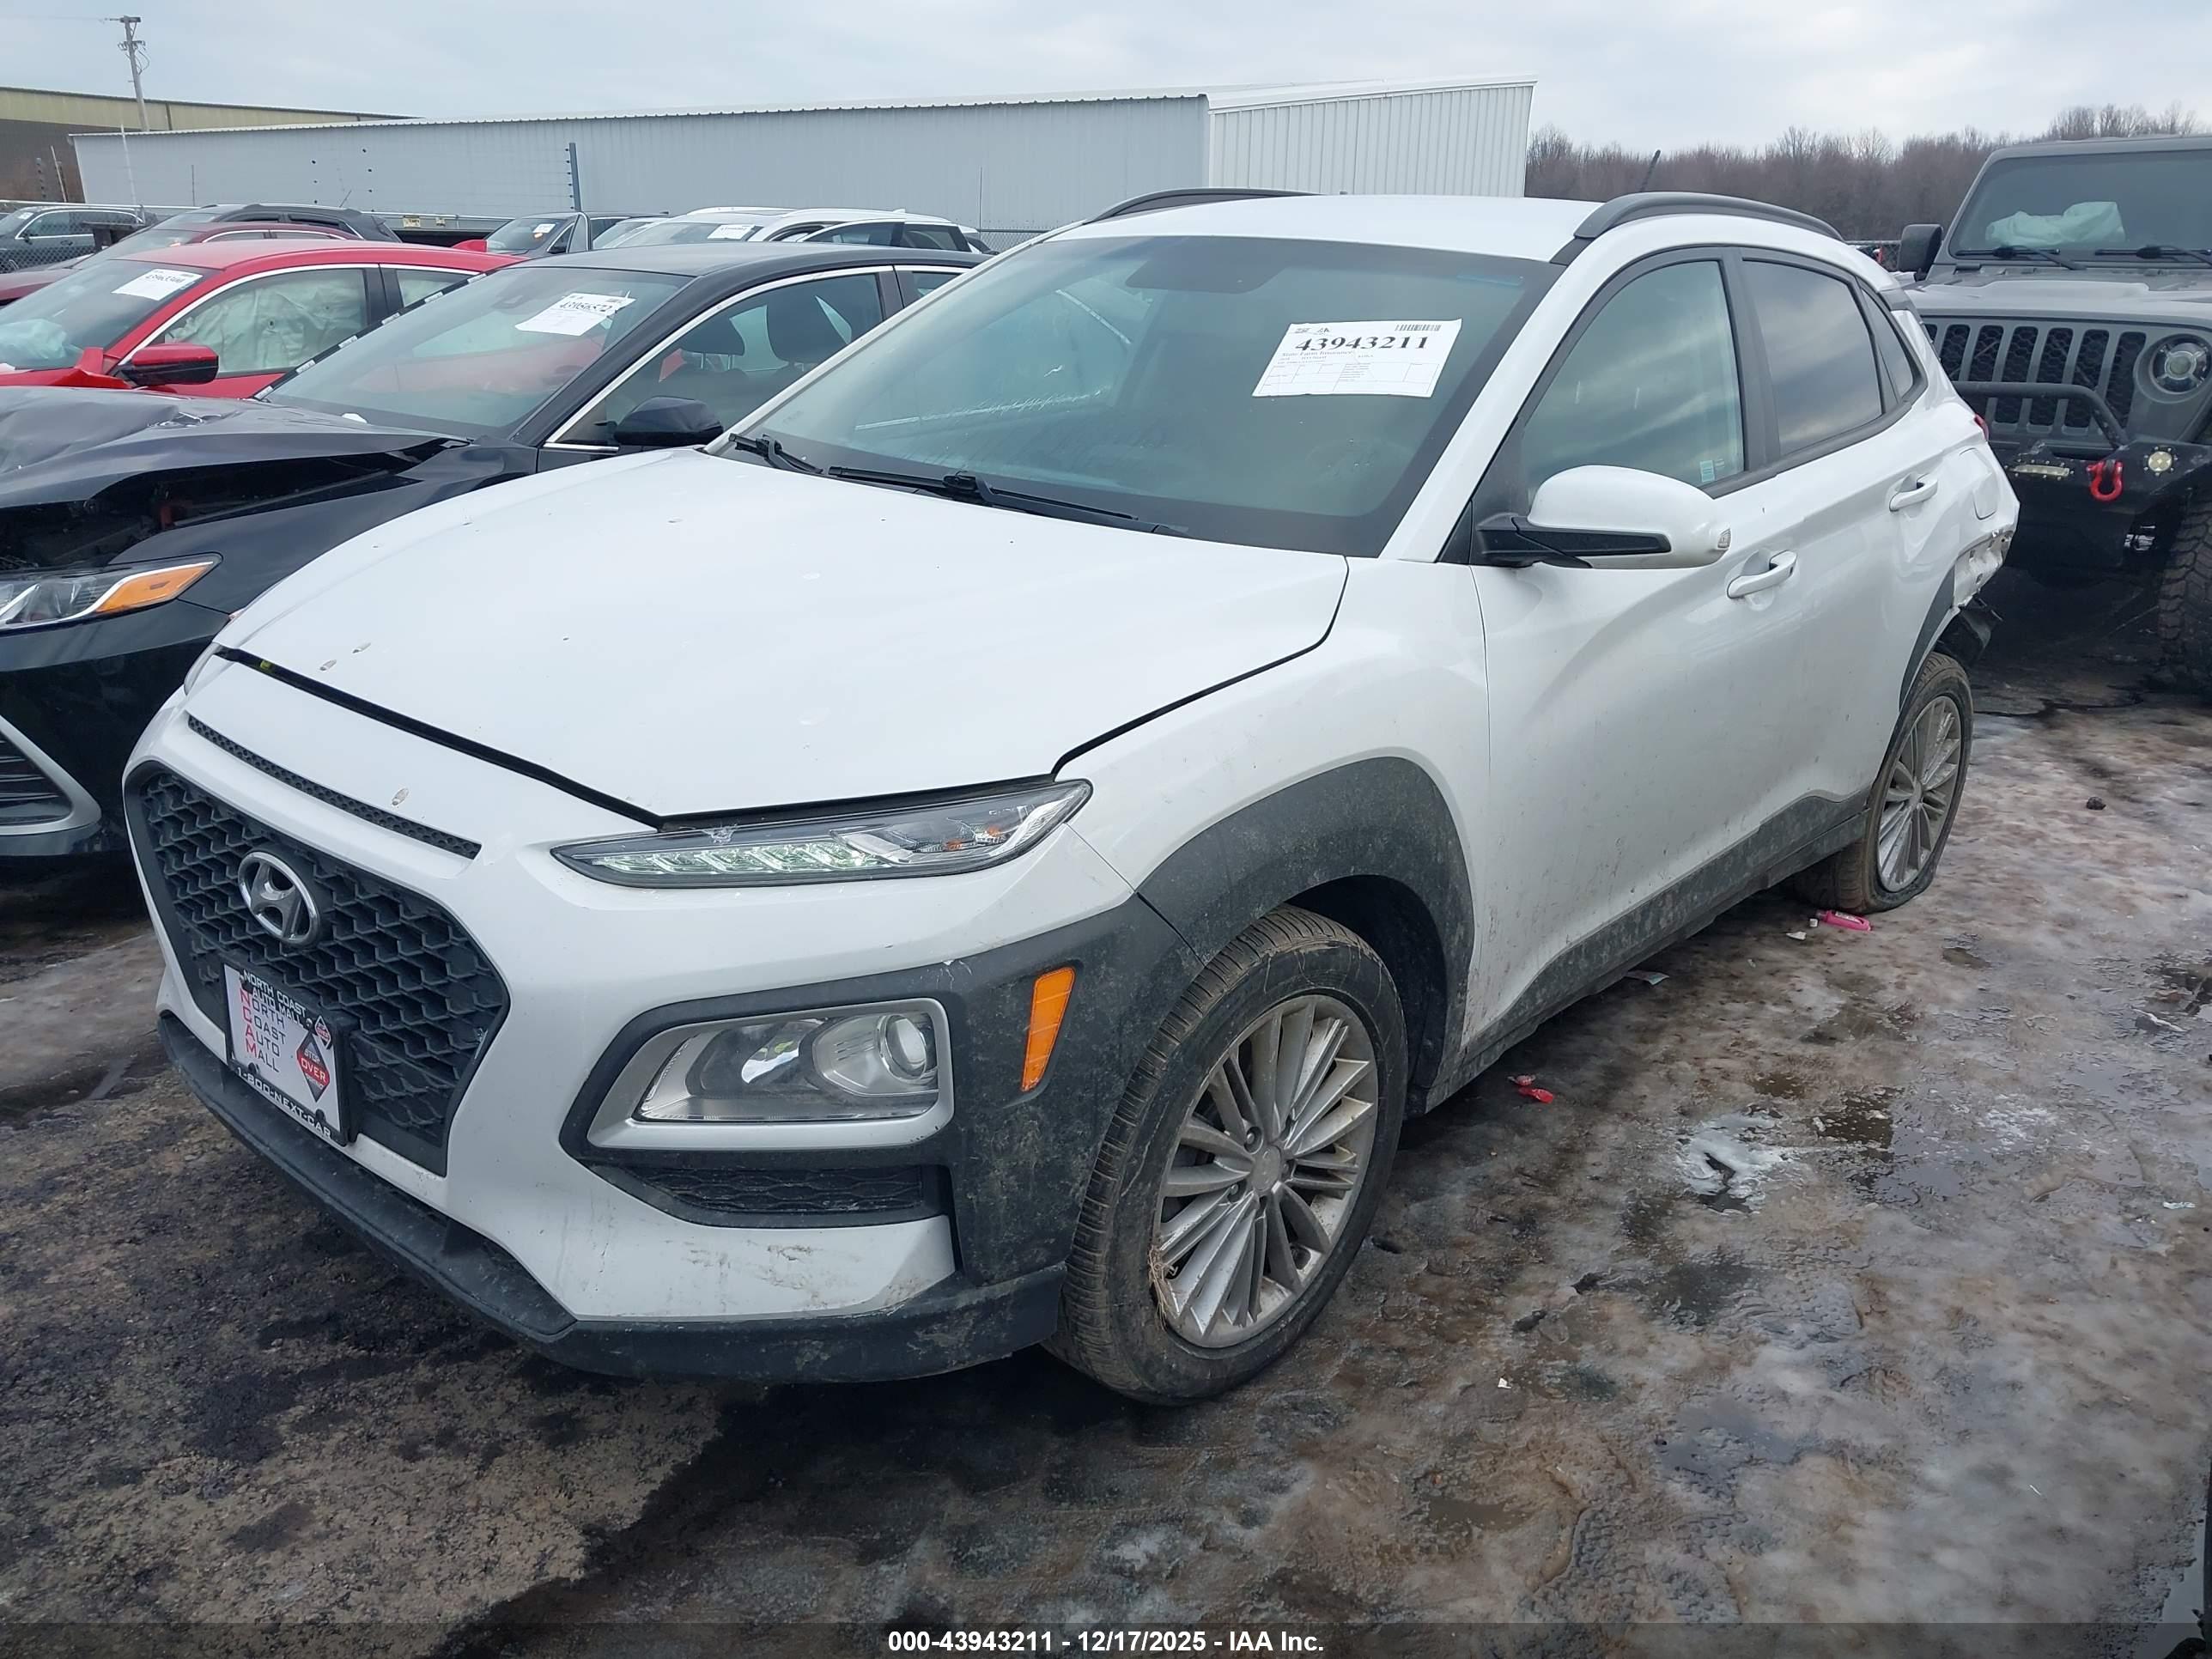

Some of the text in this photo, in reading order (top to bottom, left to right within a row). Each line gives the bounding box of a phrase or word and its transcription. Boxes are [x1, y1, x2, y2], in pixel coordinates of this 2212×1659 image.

[1295, 336, 1429, 351] 43943211
[240, 988, 285, 1030] NORTH
[243, 969, 307, 1018] NORTH COAST
[252, 987, 300, 1024] AUTO MALL
[243, 1006, 286, 1045] COAST
[246, 1023, 280, 1057] AUTO
[246, 1037, 280, 1073] MALL
[301, 1057, 326, 1083] OVER
[304, 1048, 320, 1065] STOP
[237, 1066, 331, 1139] 1-800-NEXT-CAR
